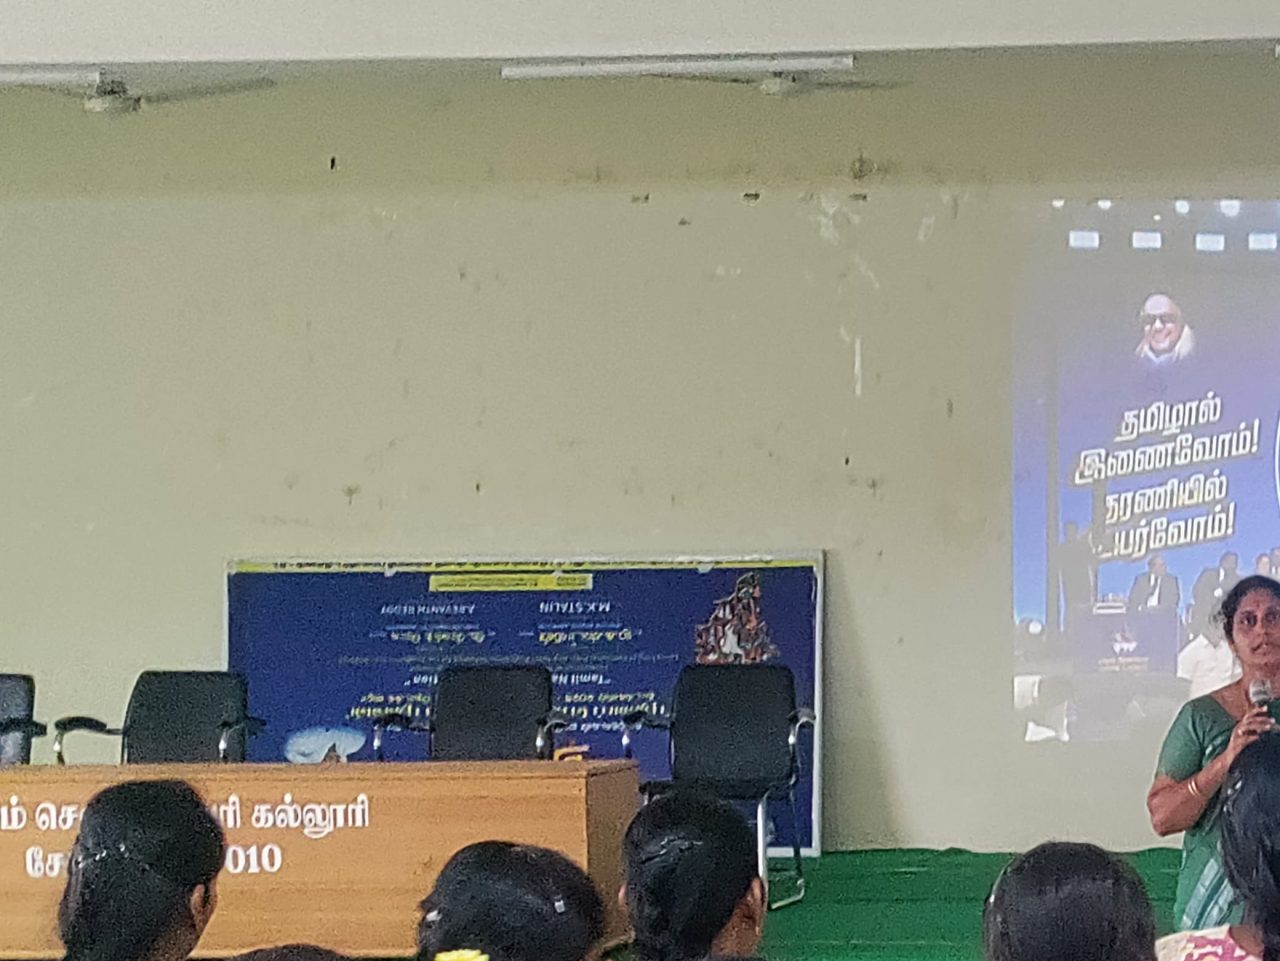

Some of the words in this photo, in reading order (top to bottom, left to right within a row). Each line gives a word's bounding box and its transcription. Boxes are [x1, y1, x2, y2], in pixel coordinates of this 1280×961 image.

[1114, 390, 1222, 442] தமிழால்
[1075, 418, 1260, 484] இணைவோம்!
[1098, 501, 1236, 559] யர்வோம்!
[251, 792, 369, 839] கல்லூரி
